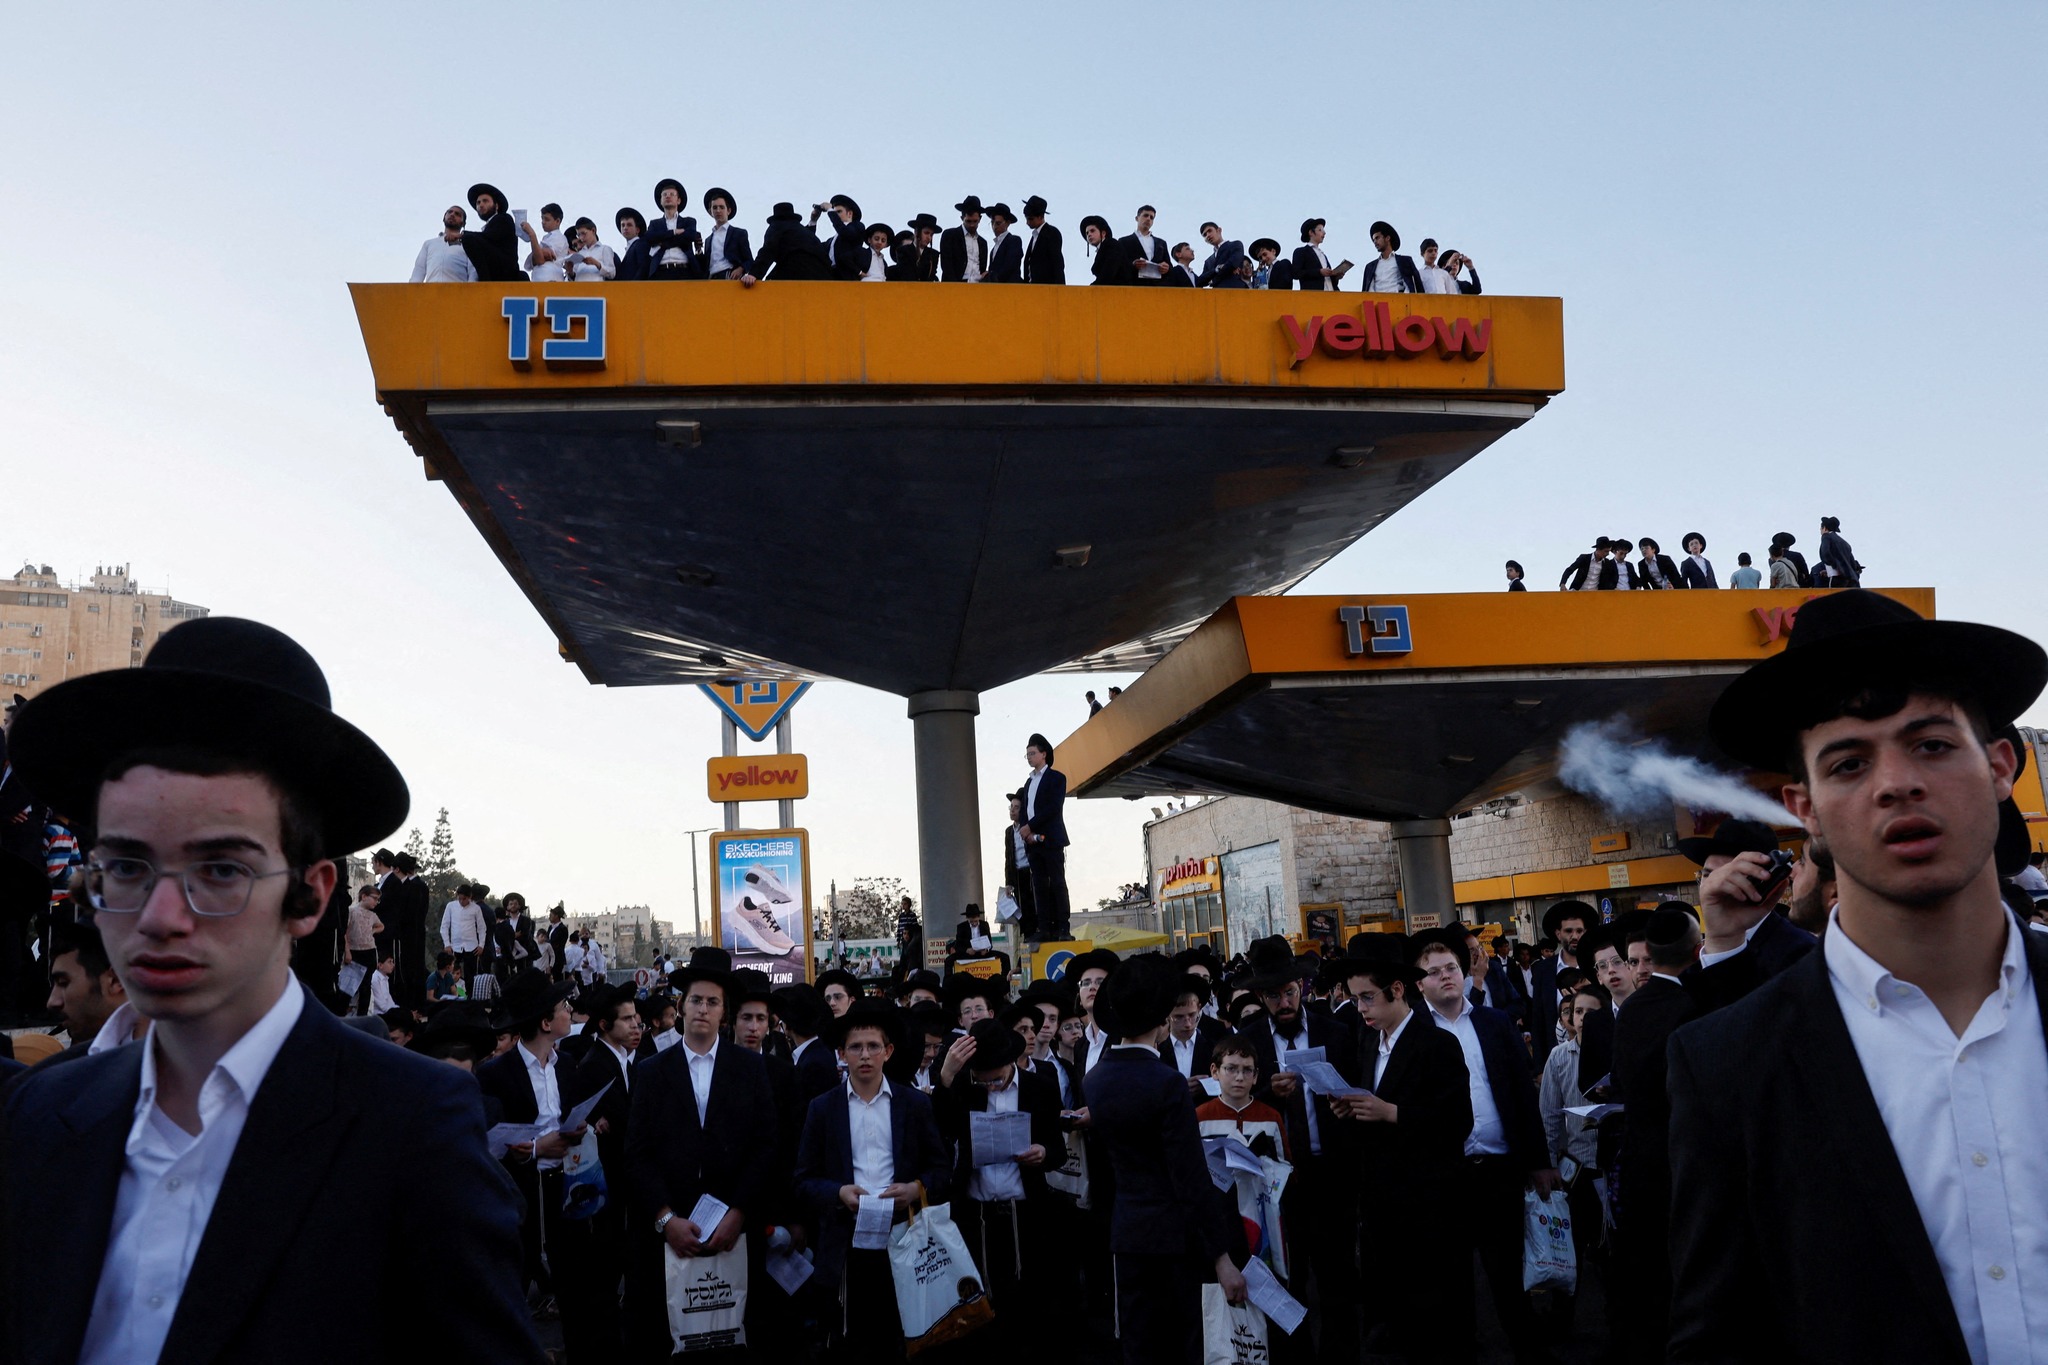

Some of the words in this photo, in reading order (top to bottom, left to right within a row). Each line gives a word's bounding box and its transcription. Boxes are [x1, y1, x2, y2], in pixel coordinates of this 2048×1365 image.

[501, 296, 606, 361] פז
[1278, 300, 1493, 368] yellow
[1340, 605, 1413, 653] פז
[717, 765, 799, 792] yellow
[725, 841, 794, 853] SKECHERS
[750, 849, 793, 858] CUSHIONING
[827, 946, 871, 961] אלן
[684, 1280, 733, 1307] גלינסקי
